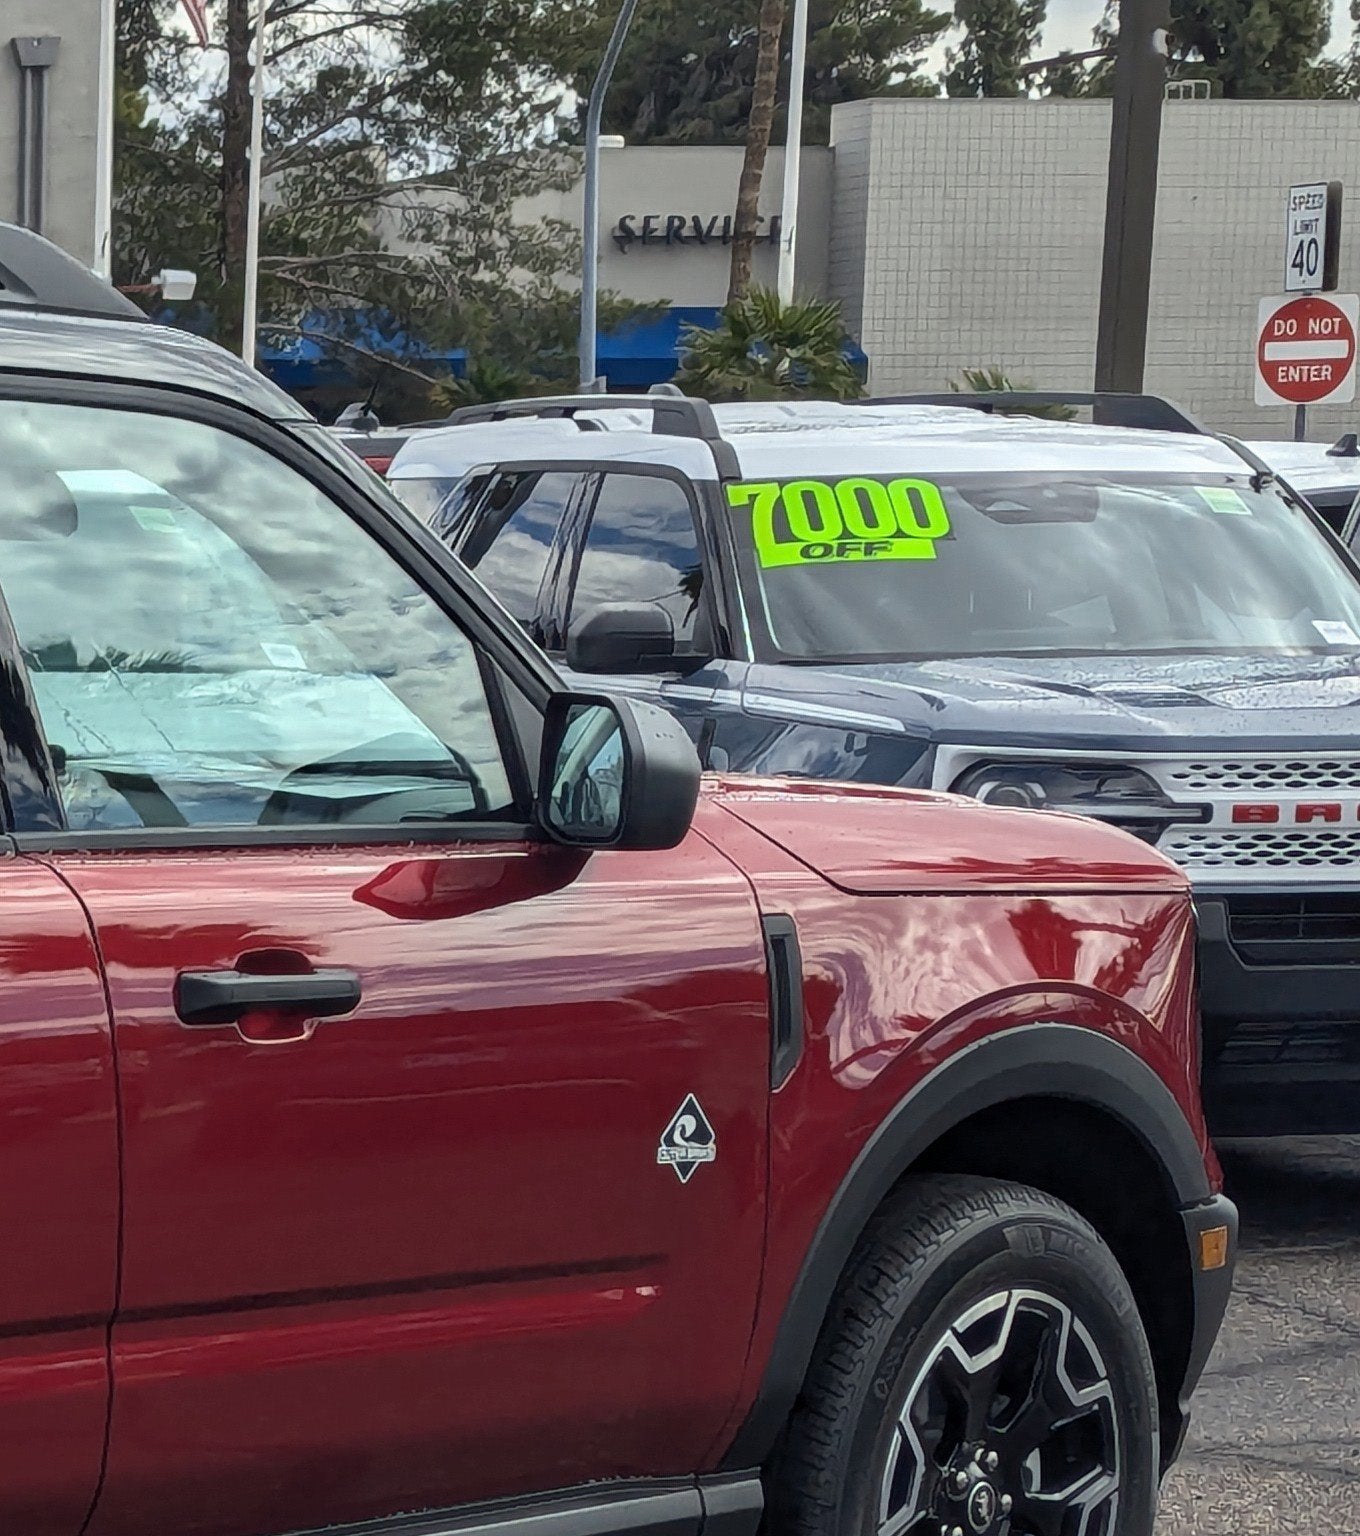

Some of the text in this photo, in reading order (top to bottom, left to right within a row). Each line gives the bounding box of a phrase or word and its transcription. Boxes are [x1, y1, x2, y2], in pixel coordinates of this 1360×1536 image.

[1291, 193, 1324, 212] SPEED
[617, 214, 784, 247] SERVIE
[1290, 237, 1319, 277] 40
[1273, 316, 1343, 336] DO NOT
[1277, 364, 1333, 383] ENTER
[726, 477, 951, 549] 7000
[799, 540, 894, 559] OFF
